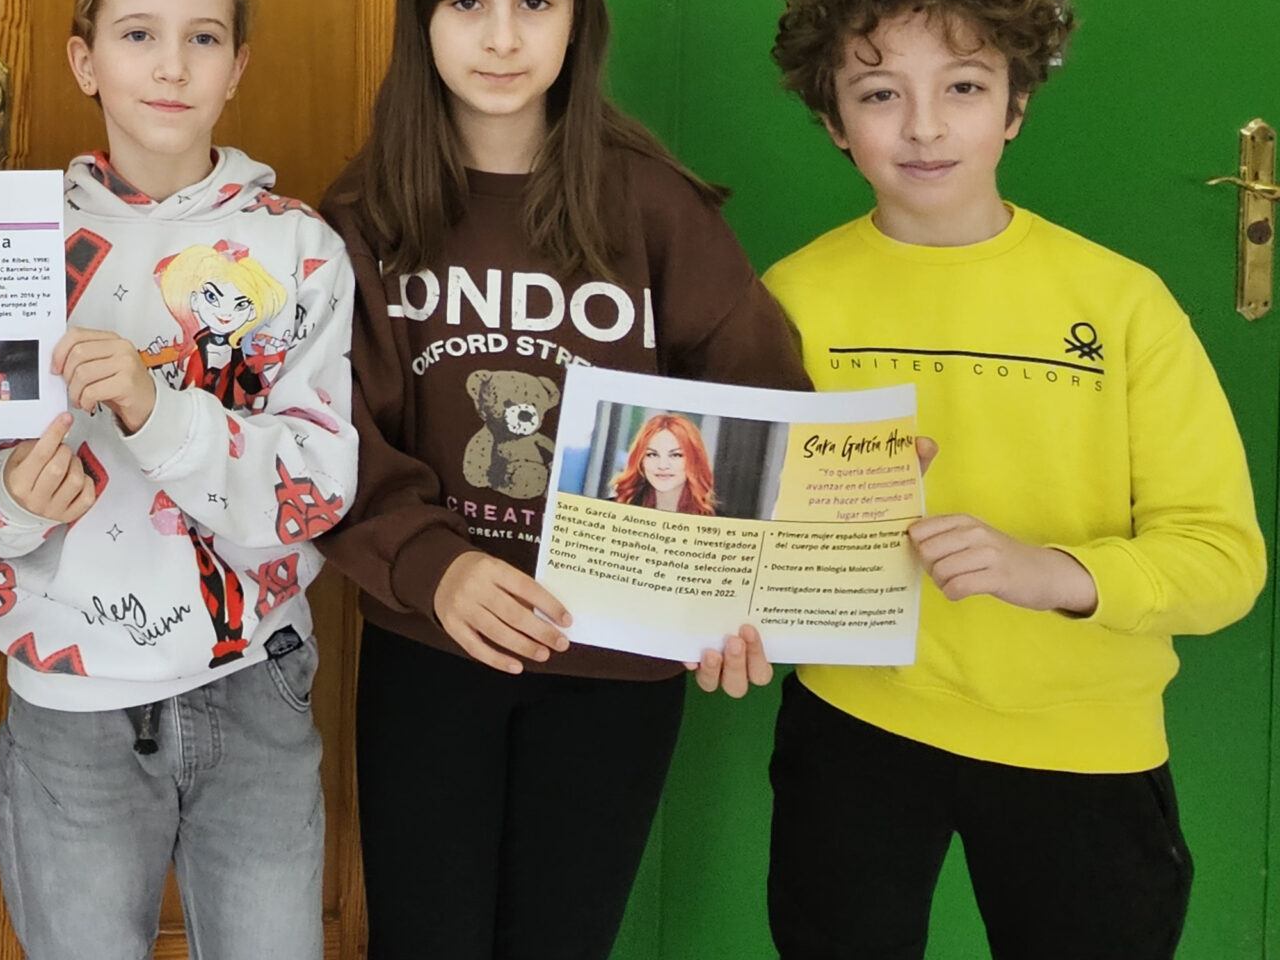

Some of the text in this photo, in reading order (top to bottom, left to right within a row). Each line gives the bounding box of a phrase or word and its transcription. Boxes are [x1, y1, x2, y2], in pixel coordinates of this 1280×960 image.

[412, 333, 508, 376] OXFORD
[830, 358, 1103, 392] UNITED COLORS
[803, 434, 836, 459] Sara
[841, 435, 882, 462] García
[446, 496, 546, 526] CREAT
[557, 501, 579, 512] Sara
[585, 507, 617, 520] García
[622, 514, 657, 527] Alonso
[662, 521, 690, 532] (León
[468, 526, 513, 539] CREATE
[553, 524, 569, 534] del
[573, 530, 606, 542] cáncer
[610, 538, 658, 554] española,
[664, 548, 717, 560] reconocida
[721, 554, 737, 562] por
[554, 513, 606, 530] destacada
[612, 524, 676, 544] biotecnóloga
[694, 538, 757, 550] investigadora
[549, 547, 750, 586] como astronauta de reserva de la
[551, 535, 752, 574] la primera mujer española seleccionada
[548, 559, 586, 574] Agencia
[588, 568, 629, 584] Espacial
[631, 578, 673, 592] Europea
[675, 586, 699, 596] (ESA)
[701, 589, 713, 597] en
